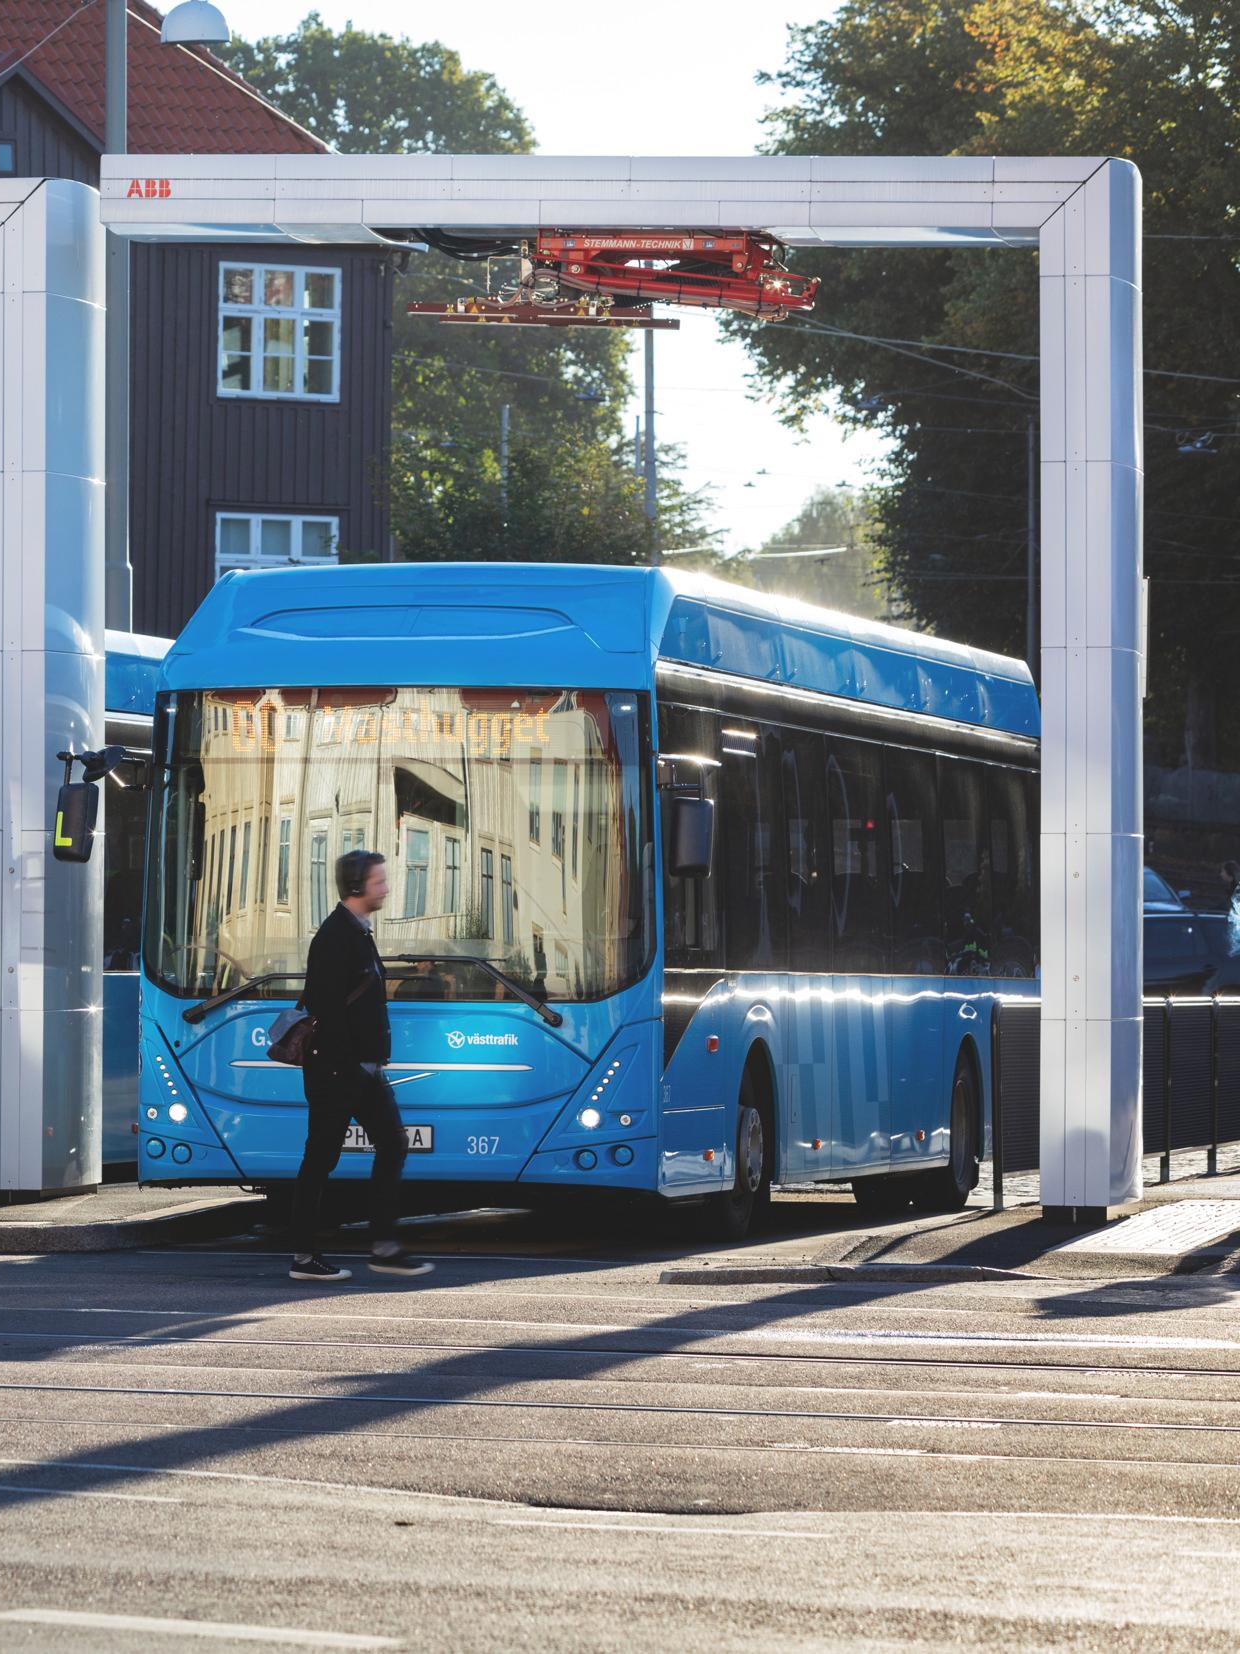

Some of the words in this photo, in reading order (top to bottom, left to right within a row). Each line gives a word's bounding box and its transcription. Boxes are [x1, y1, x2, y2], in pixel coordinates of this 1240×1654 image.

[126, 178, 171, 198] ABB
[583, 238, 682, 249] STEMMANN-TECHNIK
[251, 1027, 273, 1047] G
[466, 1032, 519, 1046] västtrafik
[466, 1136, 500, 1155] 367
